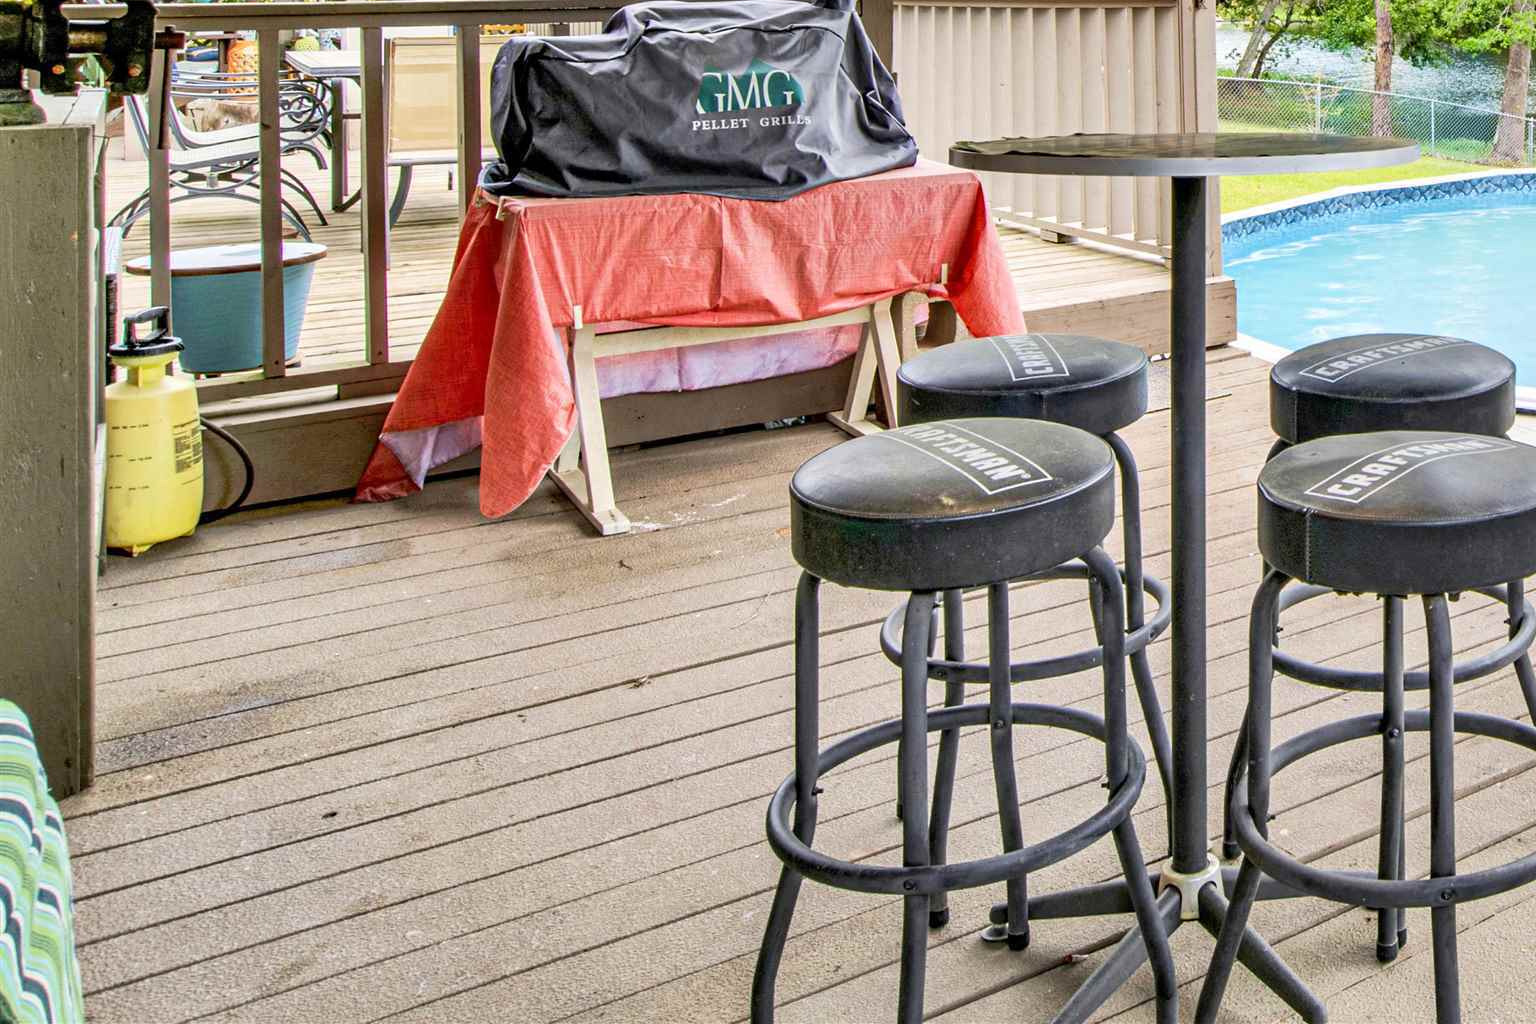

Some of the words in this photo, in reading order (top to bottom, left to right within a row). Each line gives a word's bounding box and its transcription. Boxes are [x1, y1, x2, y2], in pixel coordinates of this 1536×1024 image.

[695, 69, 795, 114] GMG
[691, 118, 750, 131] PELLET
[760, 114, 812, 128] GRILLS
[1327, 439, 1494, 496] CRAFTSMAN
